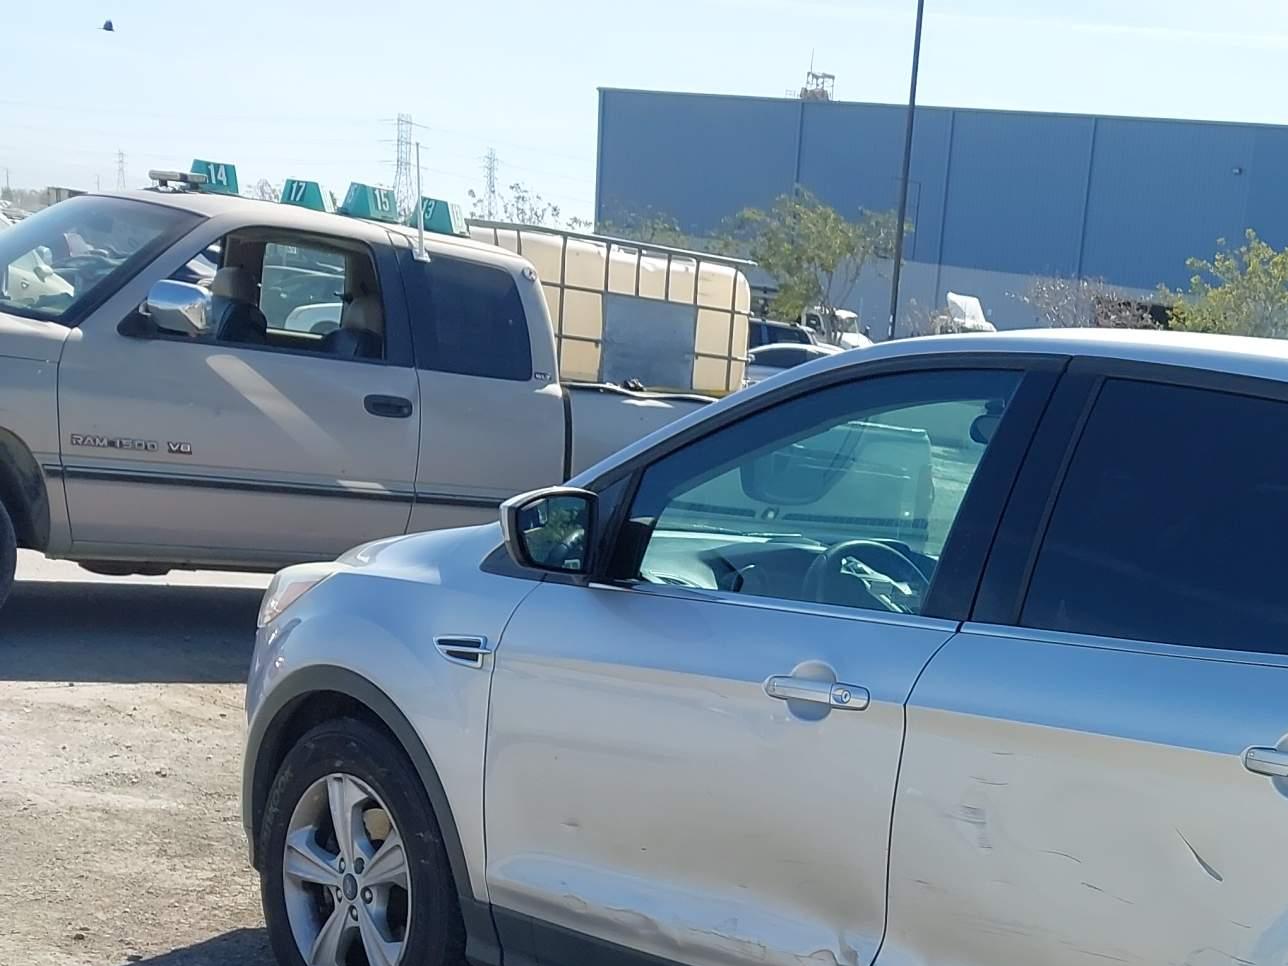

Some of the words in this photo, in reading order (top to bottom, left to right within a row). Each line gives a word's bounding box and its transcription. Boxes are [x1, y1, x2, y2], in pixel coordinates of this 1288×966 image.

[208, 163, 228, 186] 14
[290, 181, 306, 201] 17
[374, 188, 390, 212] 15
[71, 433, 108, 449] RAM
